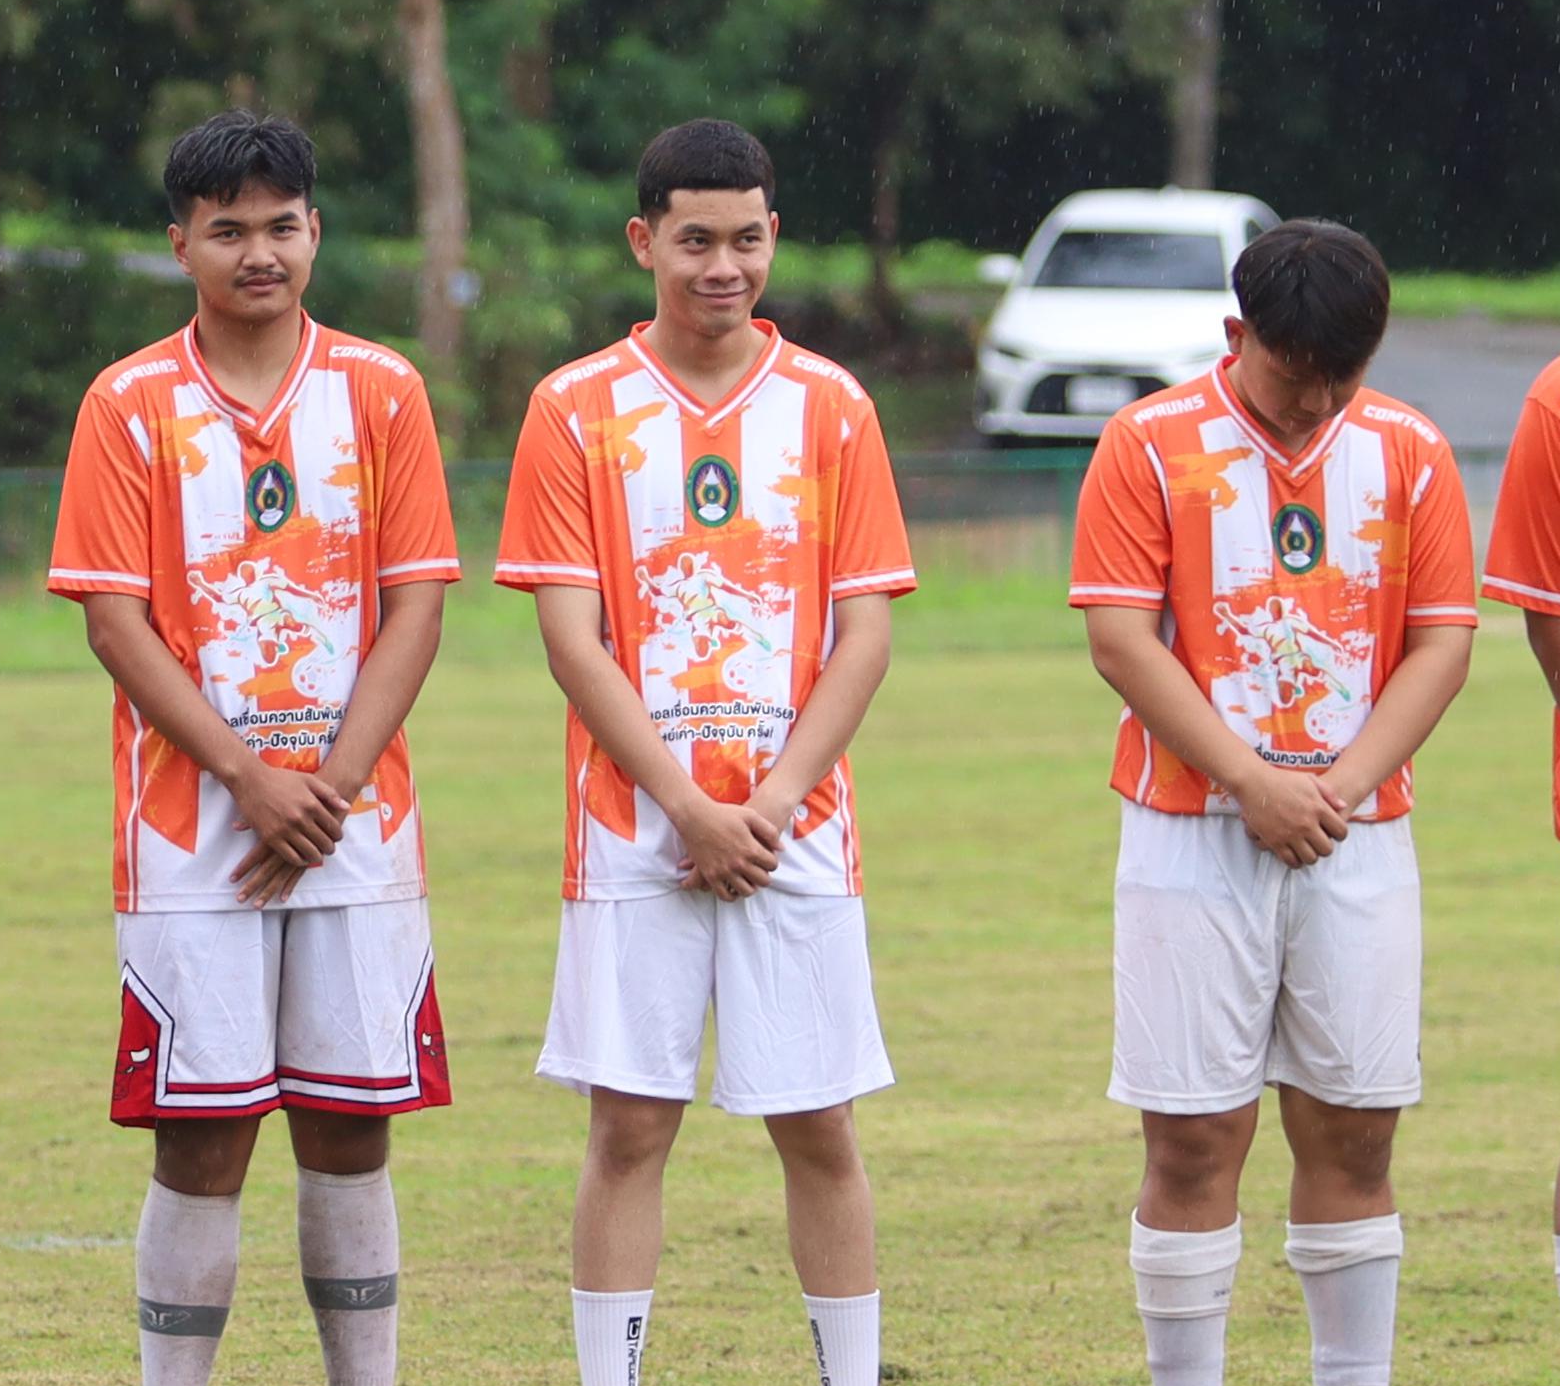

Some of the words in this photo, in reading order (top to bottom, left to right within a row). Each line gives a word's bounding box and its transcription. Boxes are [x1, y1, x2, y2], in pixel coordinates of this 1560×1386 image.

[112, 358, 180, 395] KPRUMS
[329, 345, 409, 377] COMTMS
[792, 354, 864, 400] COMTMS
[1362, 404, 1439, 444] COMTMS
